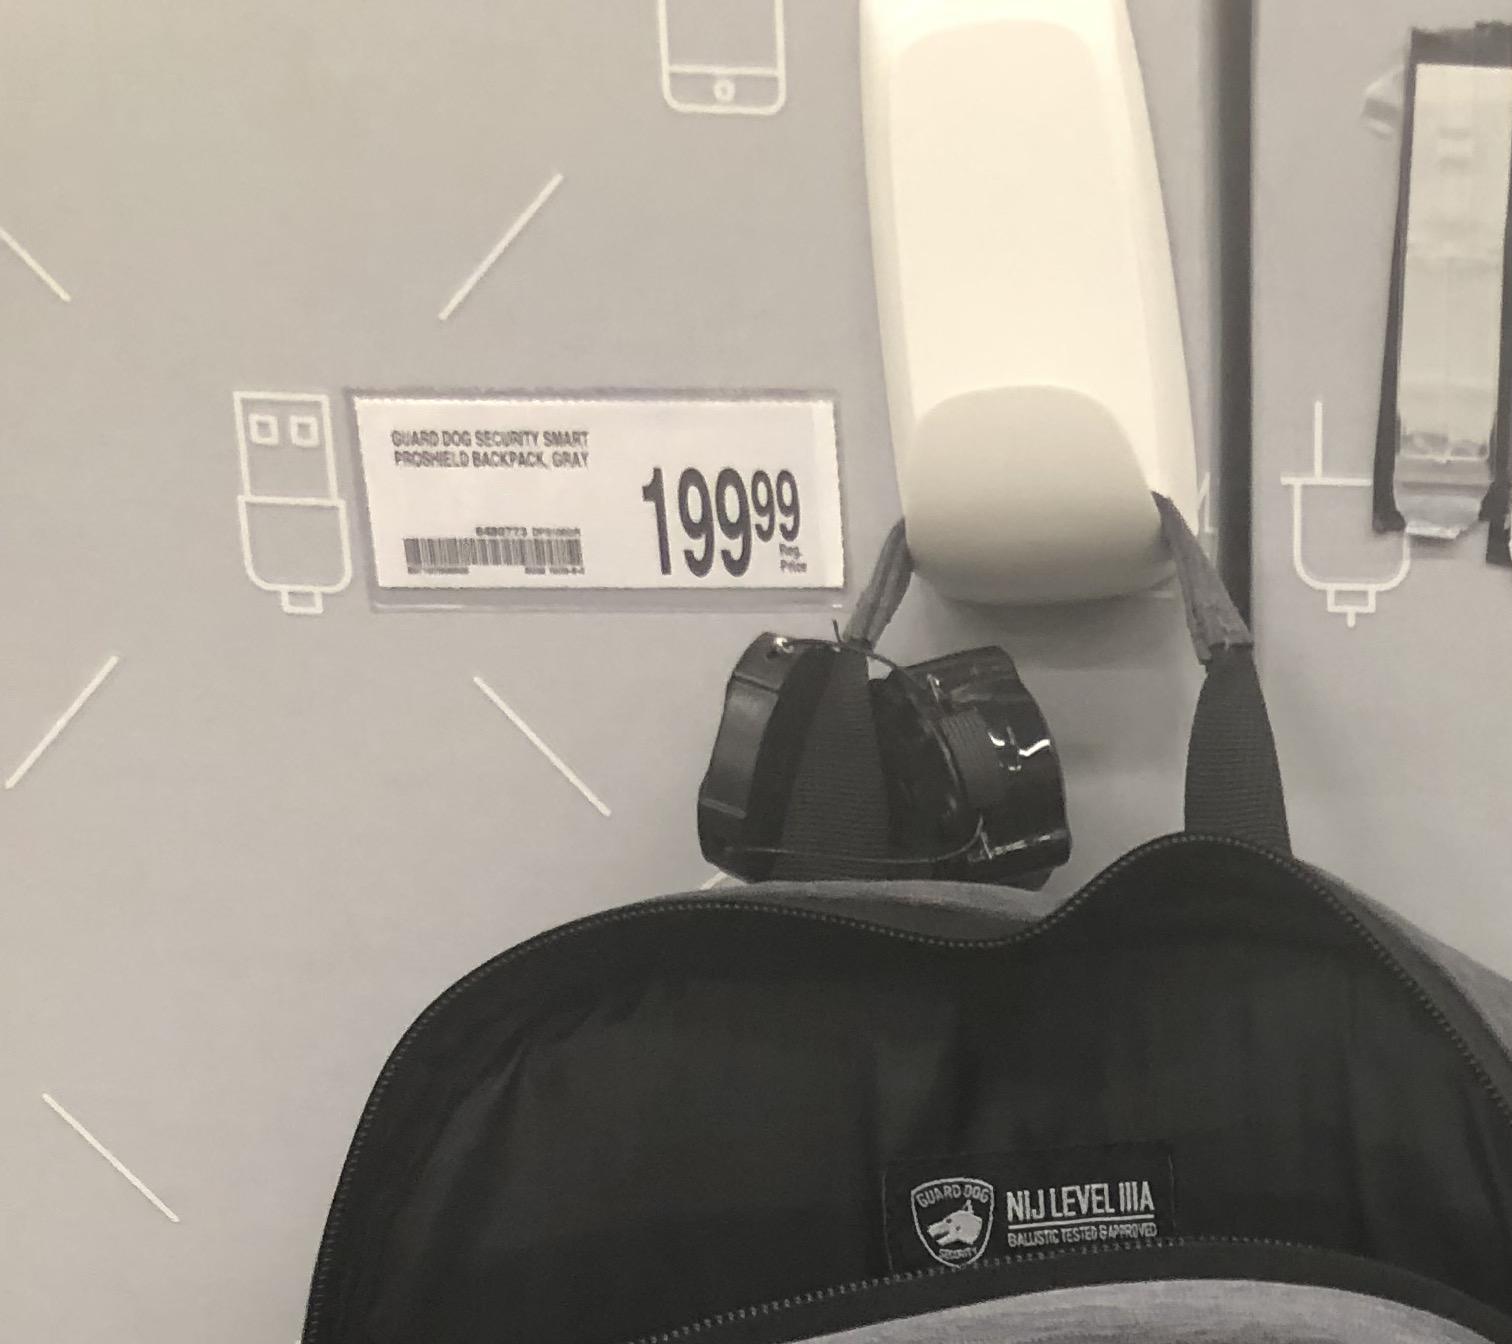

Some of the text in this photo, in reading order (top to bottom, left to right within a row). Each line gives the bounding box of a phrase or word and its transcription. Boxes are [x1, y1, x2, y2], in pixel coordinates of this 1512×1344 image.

[392, 430, 589, 447] GUARD DOG SECURITY SMART
[394, 450, 469, 468] PROSHIELD
[552, 450, 589, 468] GRAY
[916, 1185, 989, 1208] GUARD DOG
[1006, 1181, 1155, 1222] NIJ LEVEL IIIA
[1008, 1229, 1059, 1247] BALLISTIC
[1061, 1226, 1097, 1243] TESTED
[1108, 1222, 1157, 1238] APPROVED
